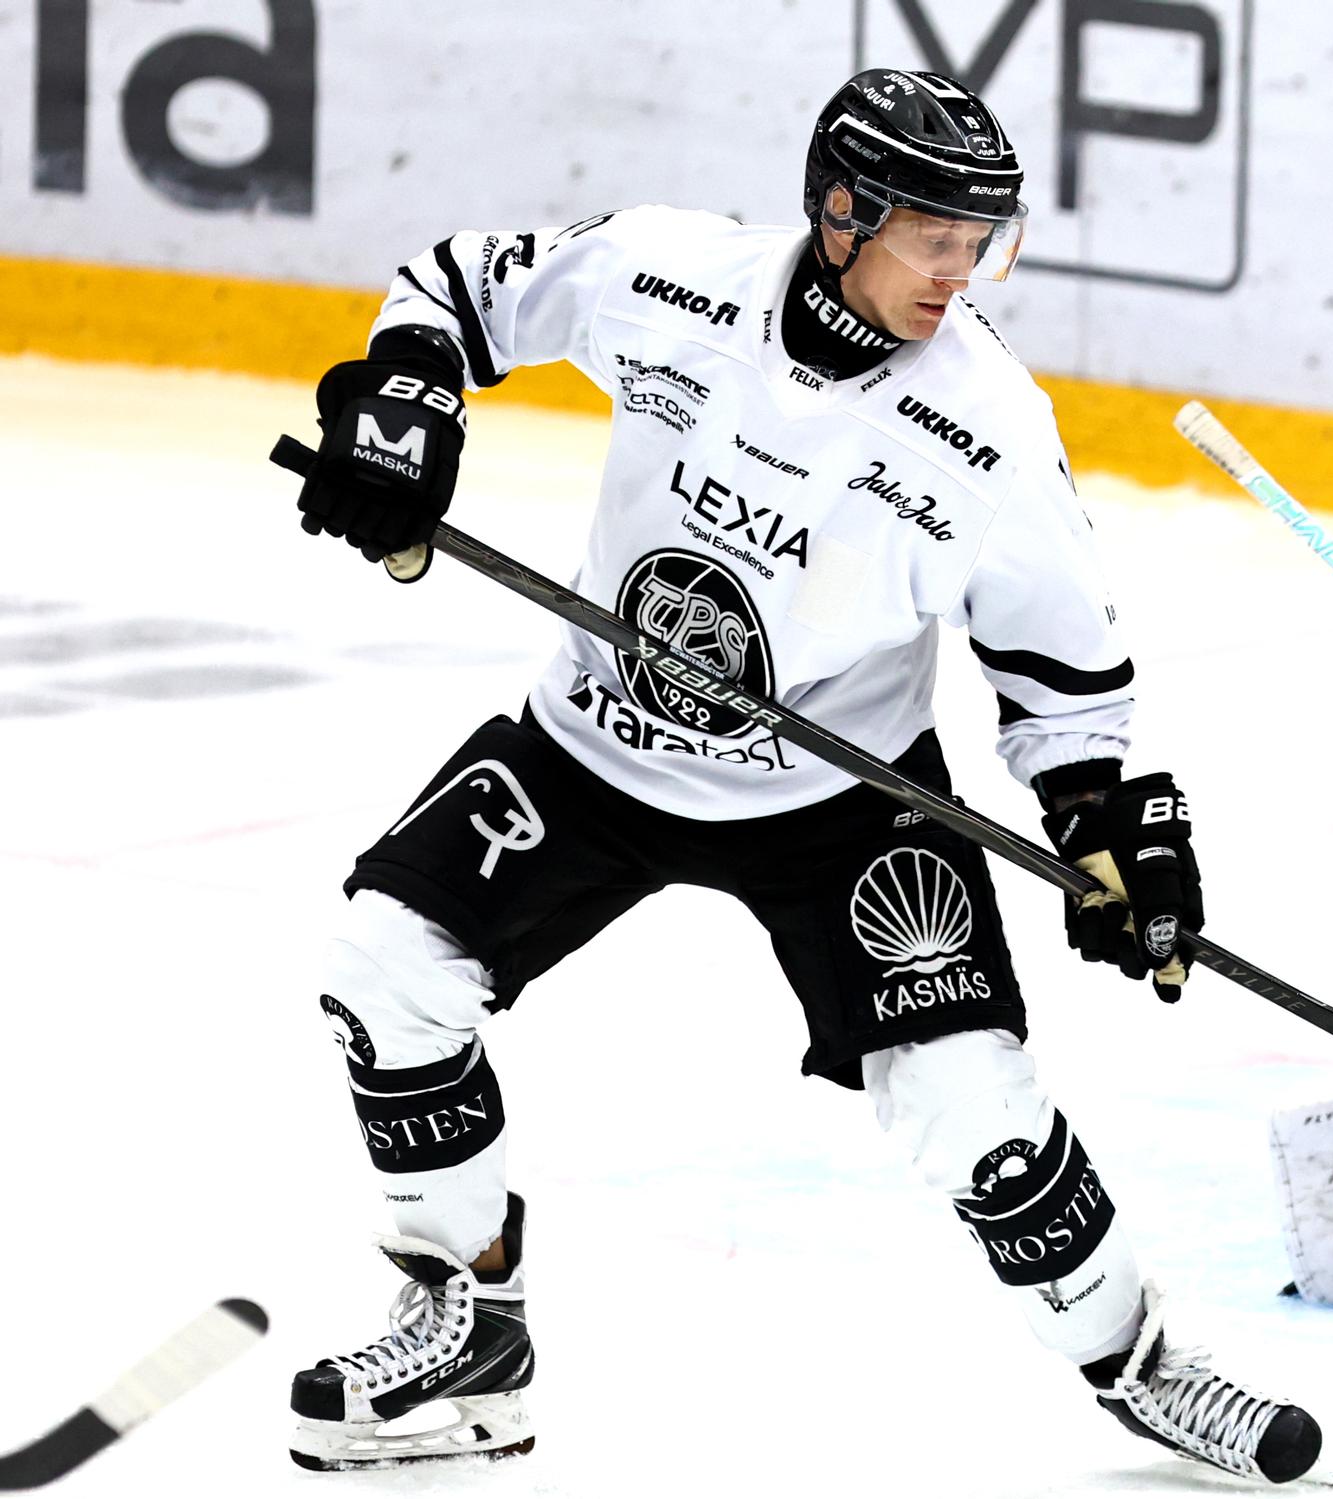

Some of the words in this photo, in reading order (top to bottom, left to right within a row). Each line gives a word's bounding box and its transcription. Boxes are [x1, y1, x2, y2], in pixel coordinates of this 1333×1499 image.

[863, 86, 896, 112] JUURI
[883, 84, 896, 95] &
[884, 72, 917, 96] JUURI
[961, 115, 981, 130] 19
[969, 185, 1012, 197] BAUER
[631, 272, 741, 327] UKKO.fi
[789, 366, 824, 391] FELIX
[860, 367, 892, 392] FELIX
[896, 395, 1002, 472] UKKO.fi
[353, 447, 421, 480] MASKU
[744, 446, 810, 479] BAUER
[670, 460, 810, 569] LEXIA
[681, 514, 712, 543] Legal
[712, 536, 775, 581] Excellence
[655, 654, 783, 728] BAUER
[661, 684, 712, 731] 1922
[873, 967, 992, 1021] KASNÄS
[1196, 950, 1308, 1013] FLYLITE
[420, 1349, 474, 1391] CCM
